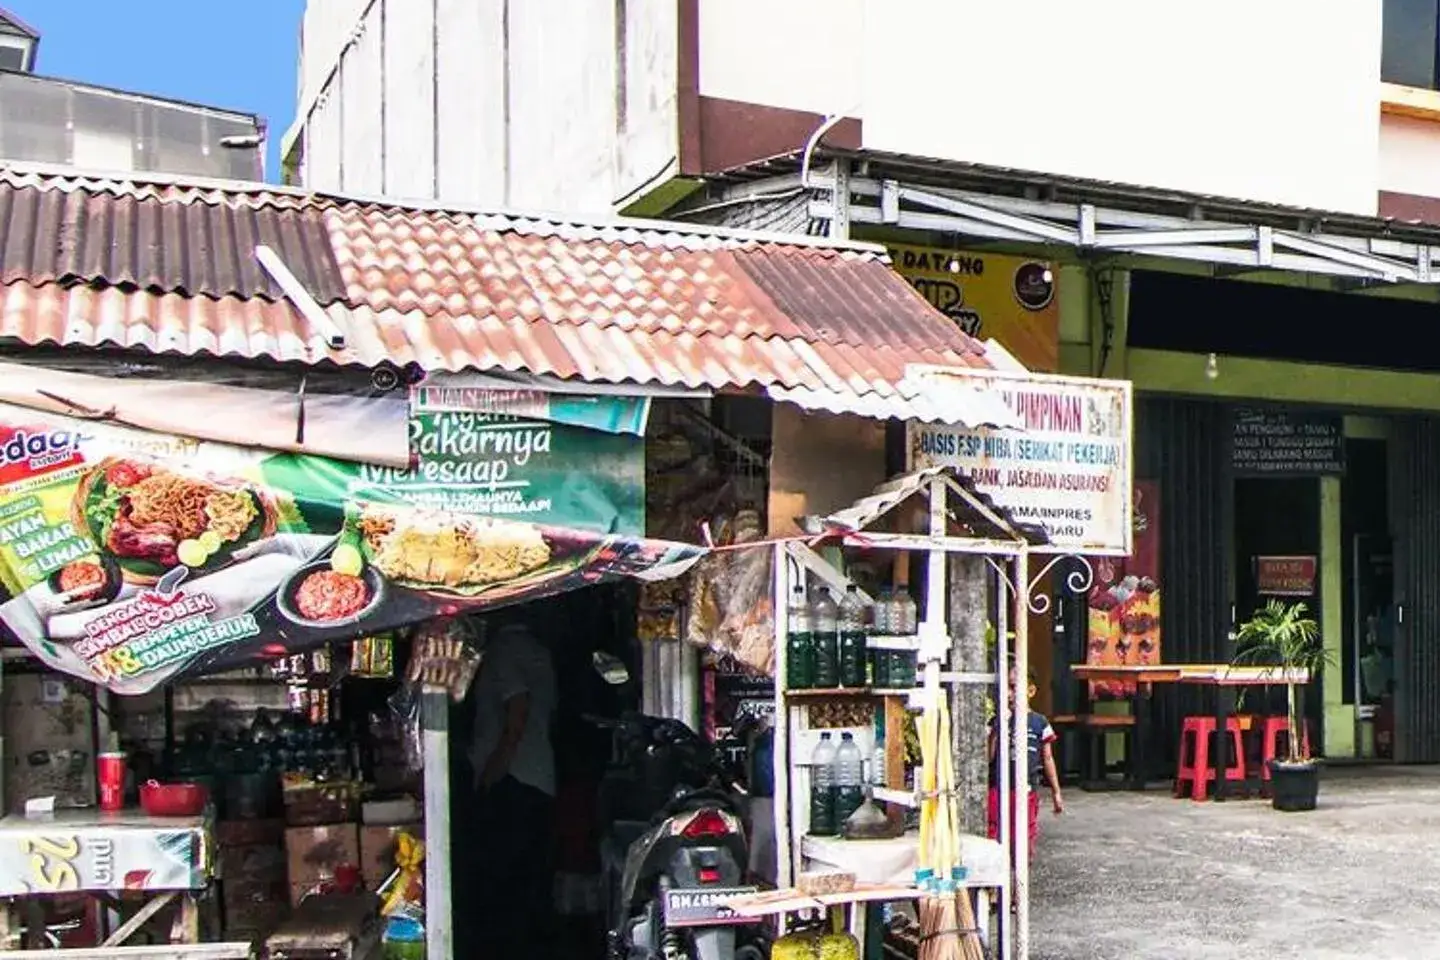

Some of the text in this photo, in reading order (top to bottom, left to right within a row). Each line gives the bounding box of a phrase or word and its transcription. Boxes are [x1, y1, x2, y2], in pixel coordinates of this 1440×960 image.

[1016, 391, 1082, 433] PIMPINAN
[920, 431, 955, 456] BASIS
[73, 593, 216, 657] SAMBAL COBEK
[86, 597, 154, 637] DENGAN
[141, 633, 196, 666] DAUN
[194, 614, 260, 650] JERUK
